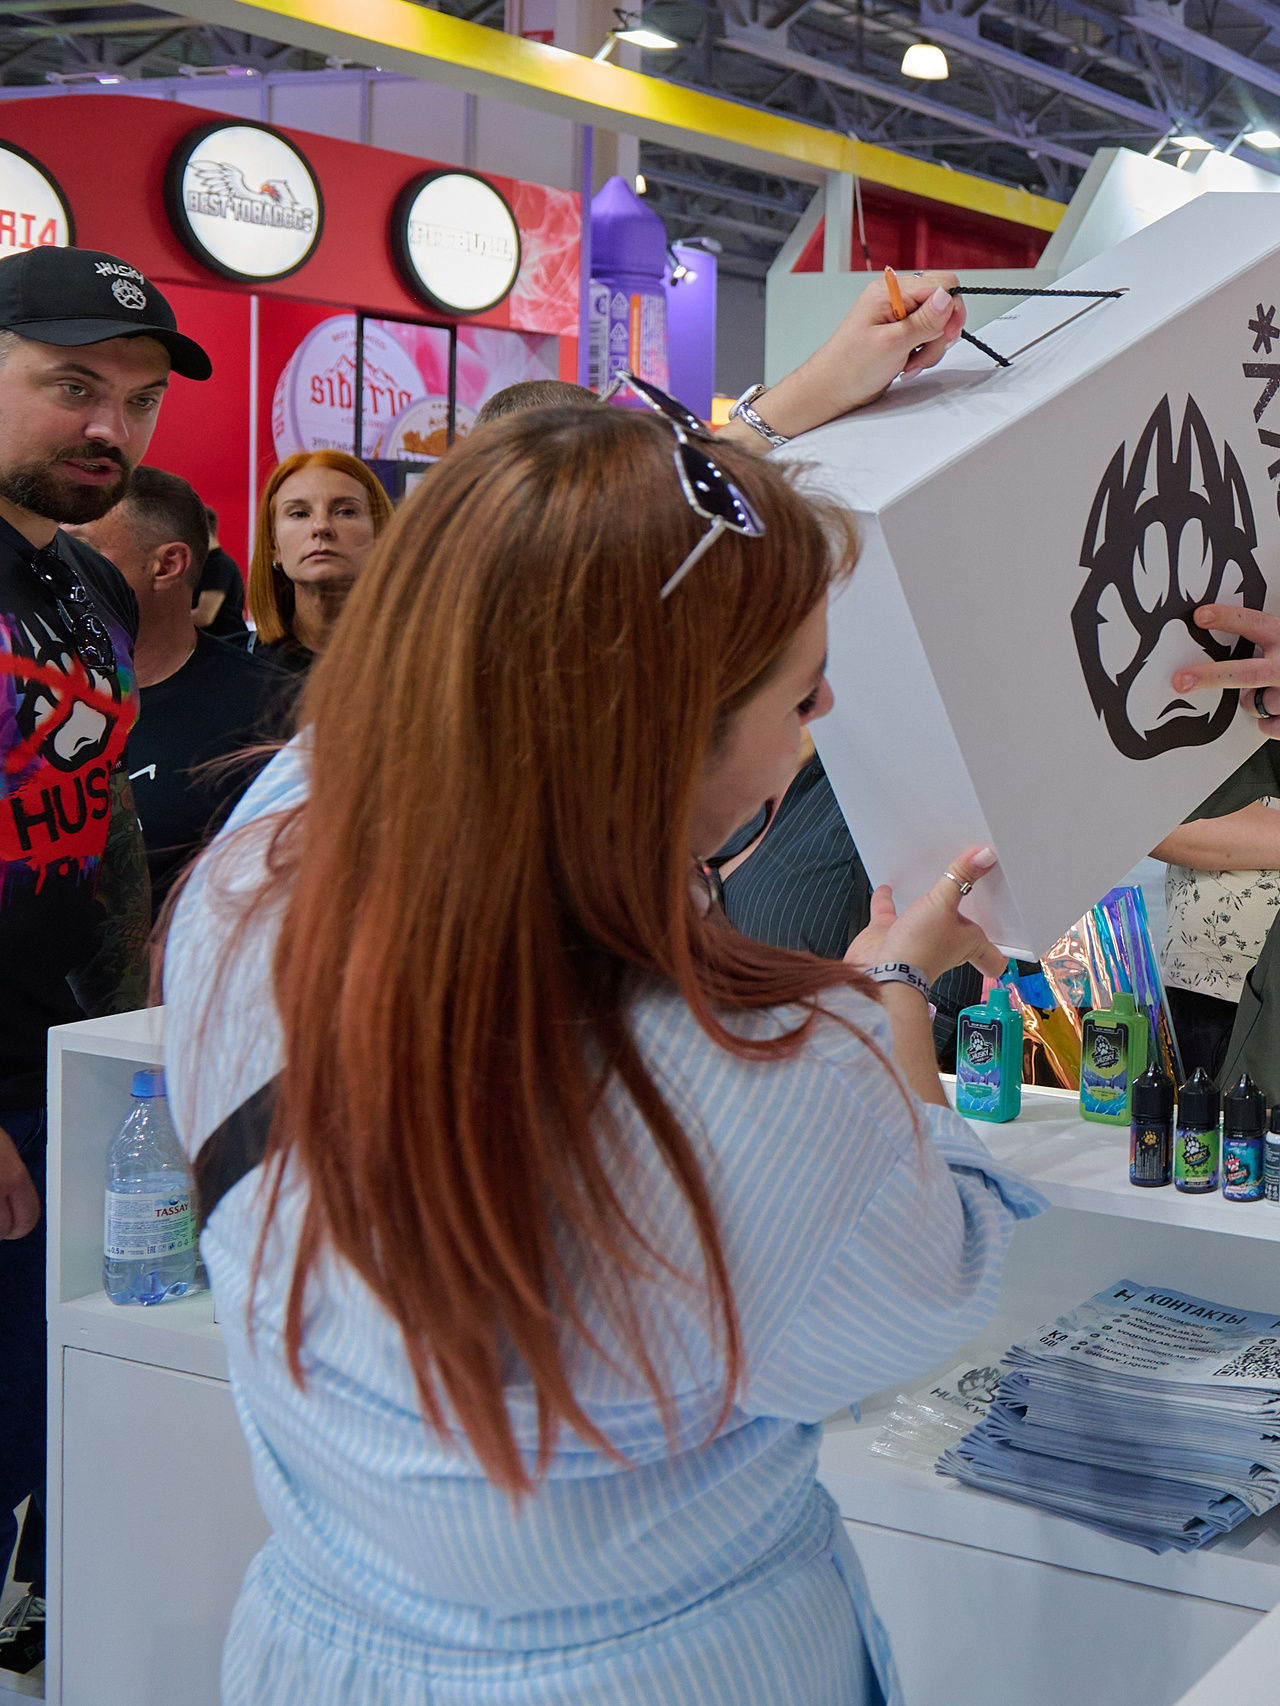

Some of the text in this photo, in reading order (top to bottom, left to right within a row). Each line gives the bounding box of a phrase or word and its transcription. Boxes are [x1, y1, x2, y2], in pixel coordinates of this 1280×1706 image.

[10, 759, 112, 852] HUS
[907, 973, 930, 992] SH
[154, 1202, 190, 1218] TASSAY
[1143, 1293, 1247, 1325] КОНТАКТЫ
